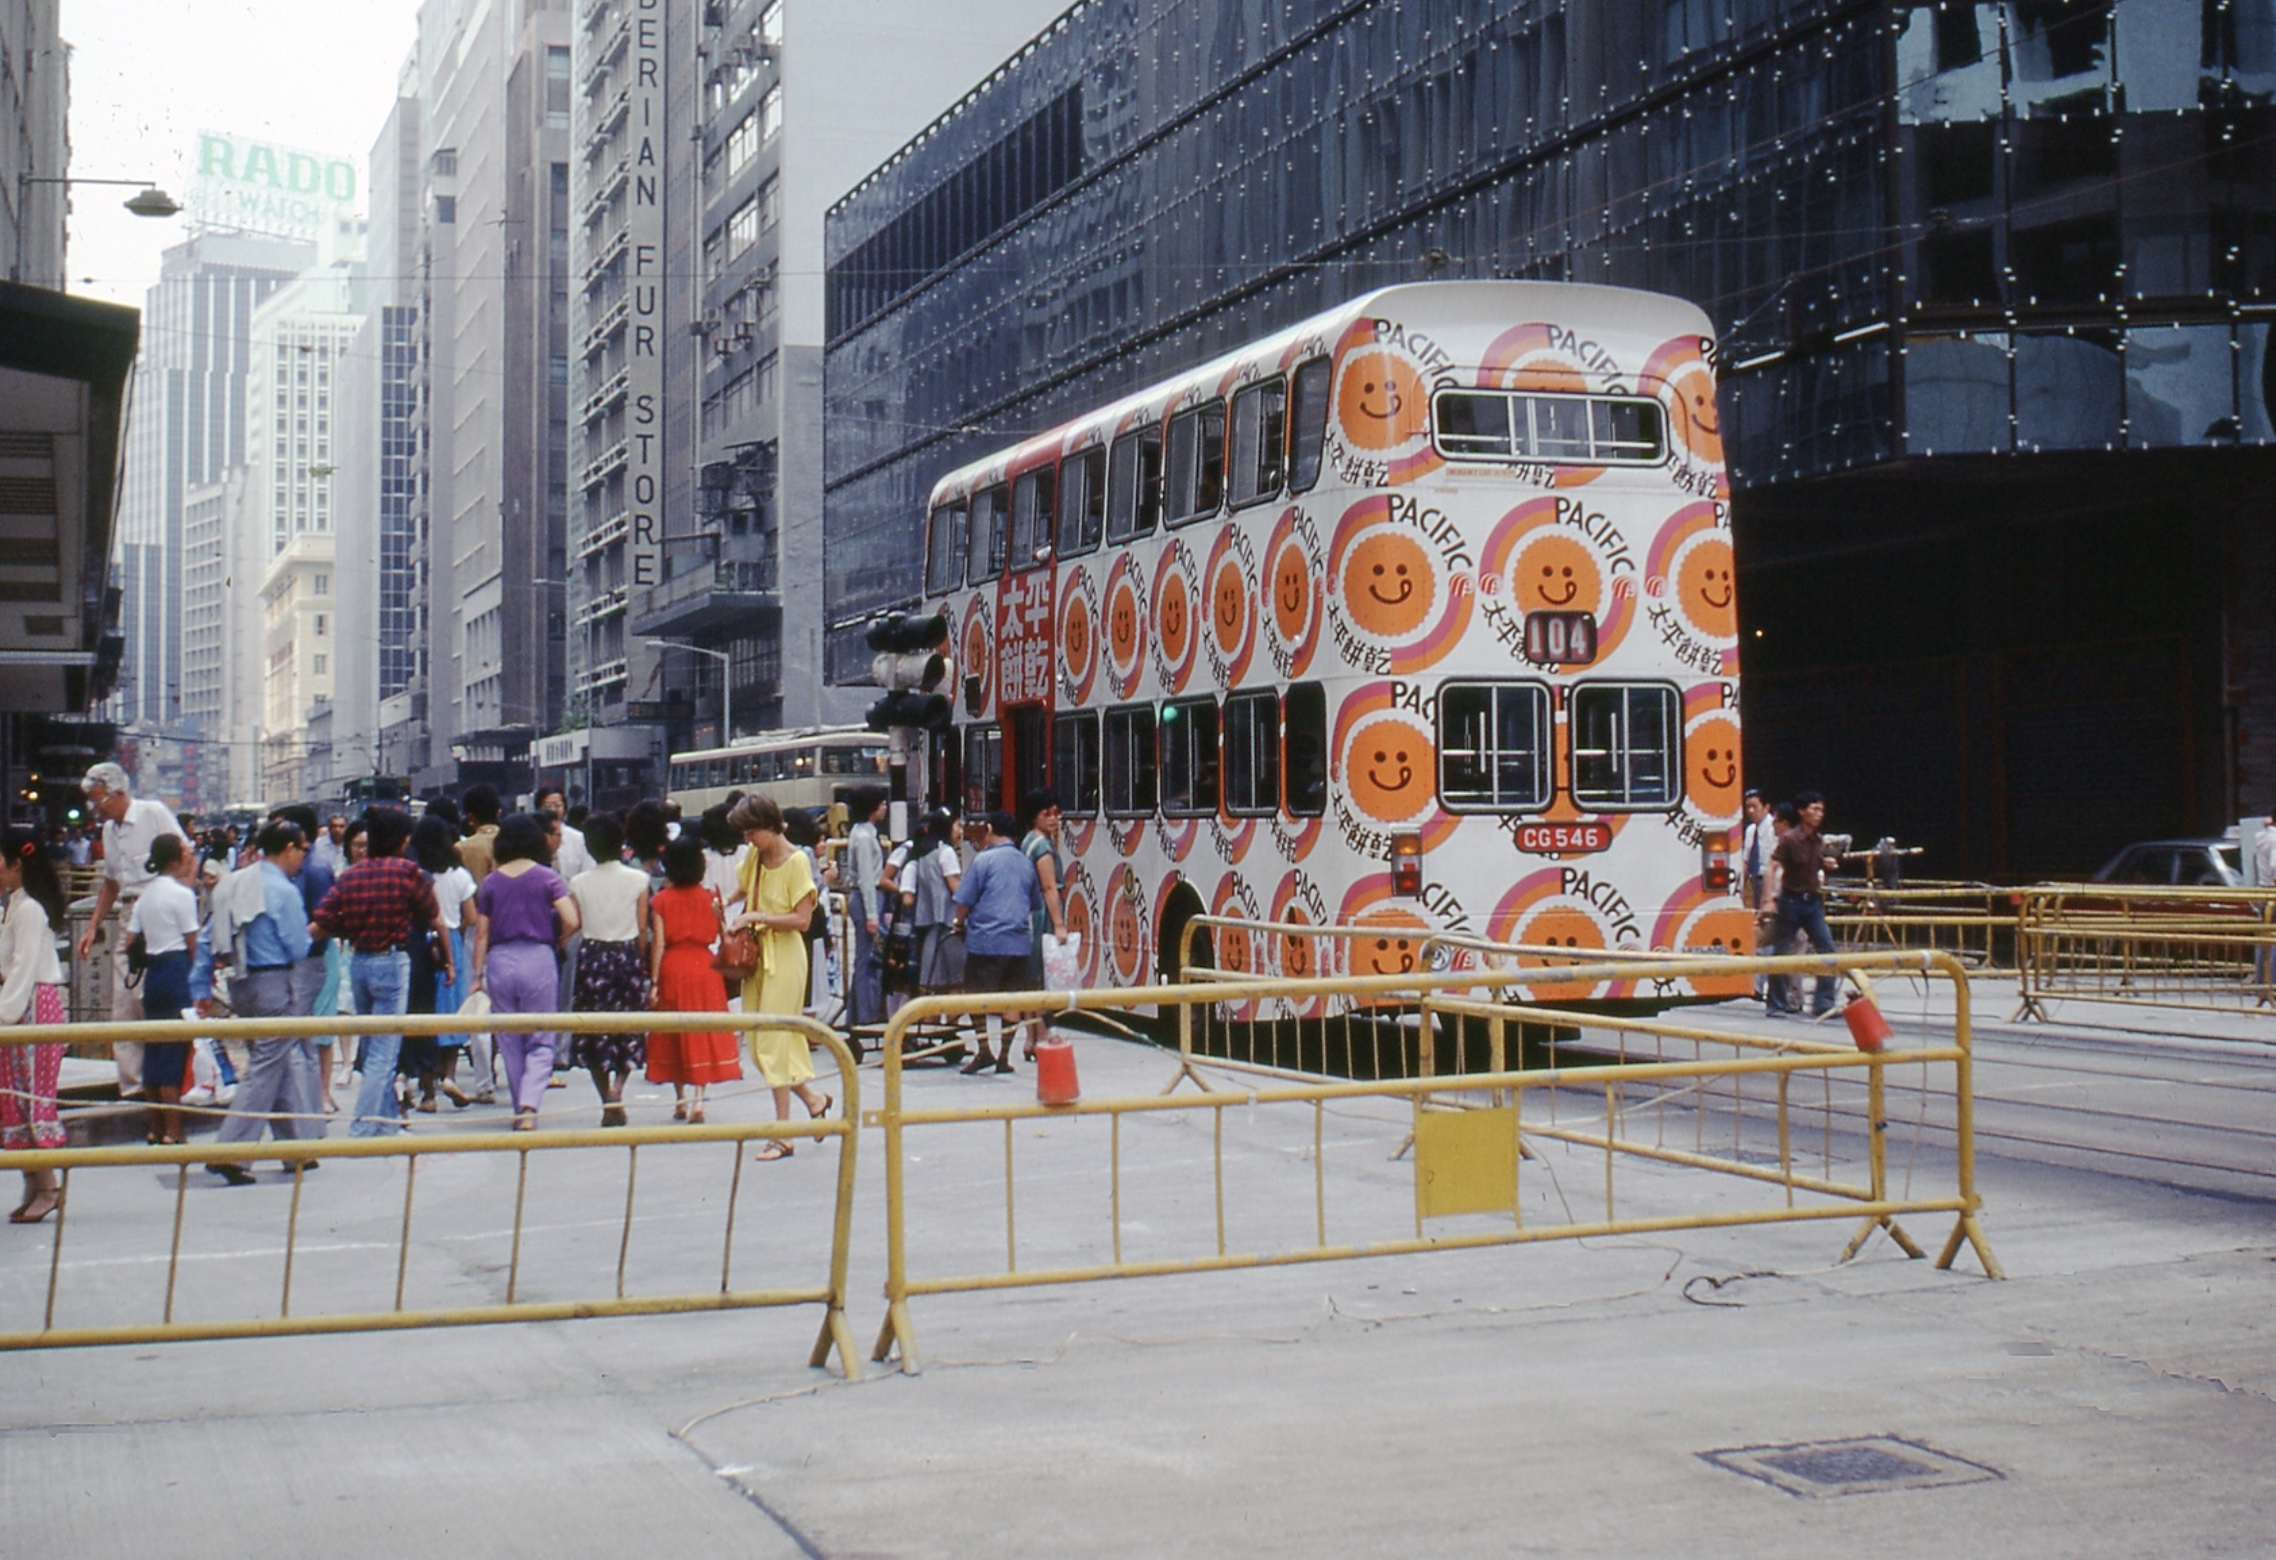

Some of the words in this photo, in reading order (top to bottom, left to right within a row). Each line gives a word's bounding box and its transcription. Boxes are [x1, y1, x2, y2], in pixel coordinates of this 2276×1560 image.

[198, 134, 356, 201] RADO
[239, 190, 319, 224] WATCH
[635, 246, 655, 357] FUR
[634, 395, 655, 586] STORE
[1230, 523, 1258, 592] PACIFIC
[1293, 506, 1324, 577] PACIFIC
[1387, 493, 1474, 572] PACIFIC
[1555, 496, 1635, 574] PACIFIC
[1174, 540, 1200, 602] PACIFIC
[1530, 617, 1588, 656] 104
[1523, 828, 1551, 848] CG
[1555, 828, 1599, 848] 546
[1561, 867, 1641, 943] PACIFIC
